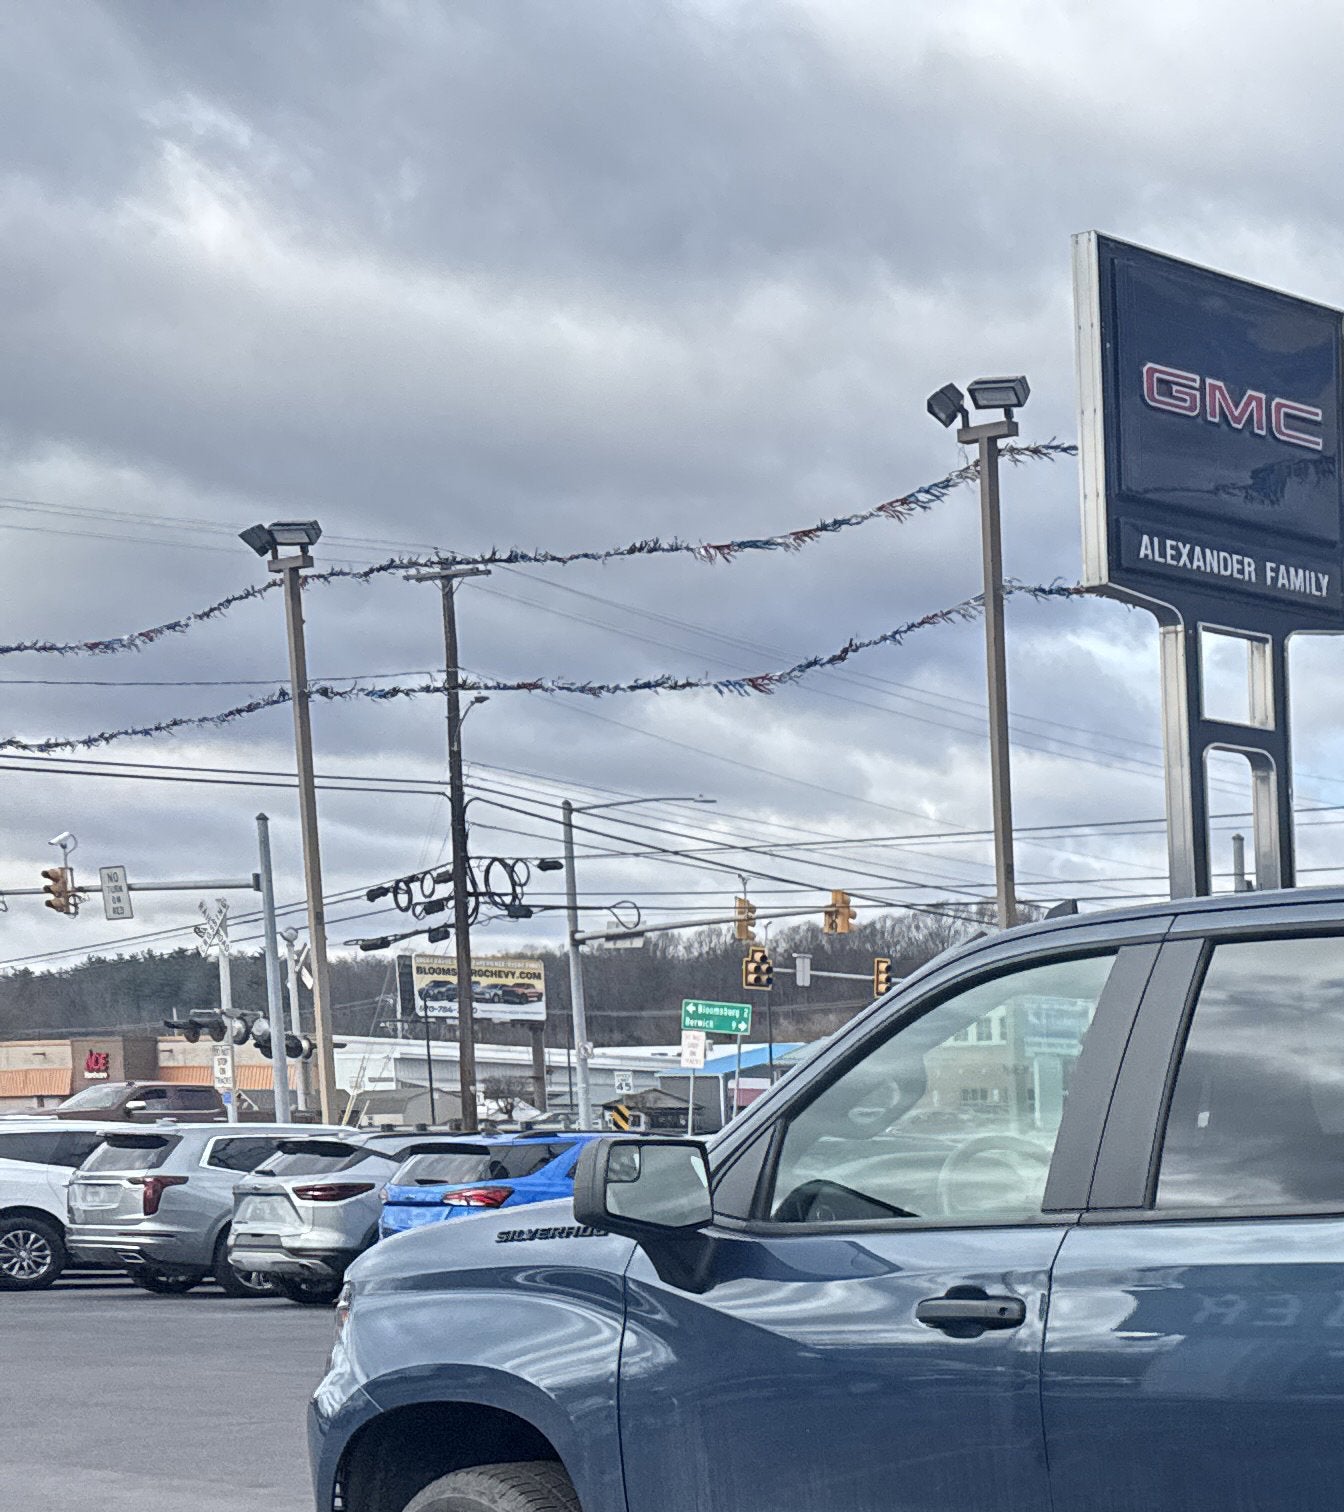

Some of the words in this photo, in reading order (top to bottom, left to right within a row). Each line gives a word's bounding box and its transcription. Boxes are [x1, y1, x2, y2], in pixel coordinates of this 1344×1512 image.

[1143, 362, 1322, 450] GMC
[1139, 535, 1256, 583] ALEXANDER
[1266, 562, 1329, 597] FAMILY
[107, 872, 118, 883] NO
[685, 1016, 714, 1029] Berwick
[616, 1082, 631, 1092] 45
